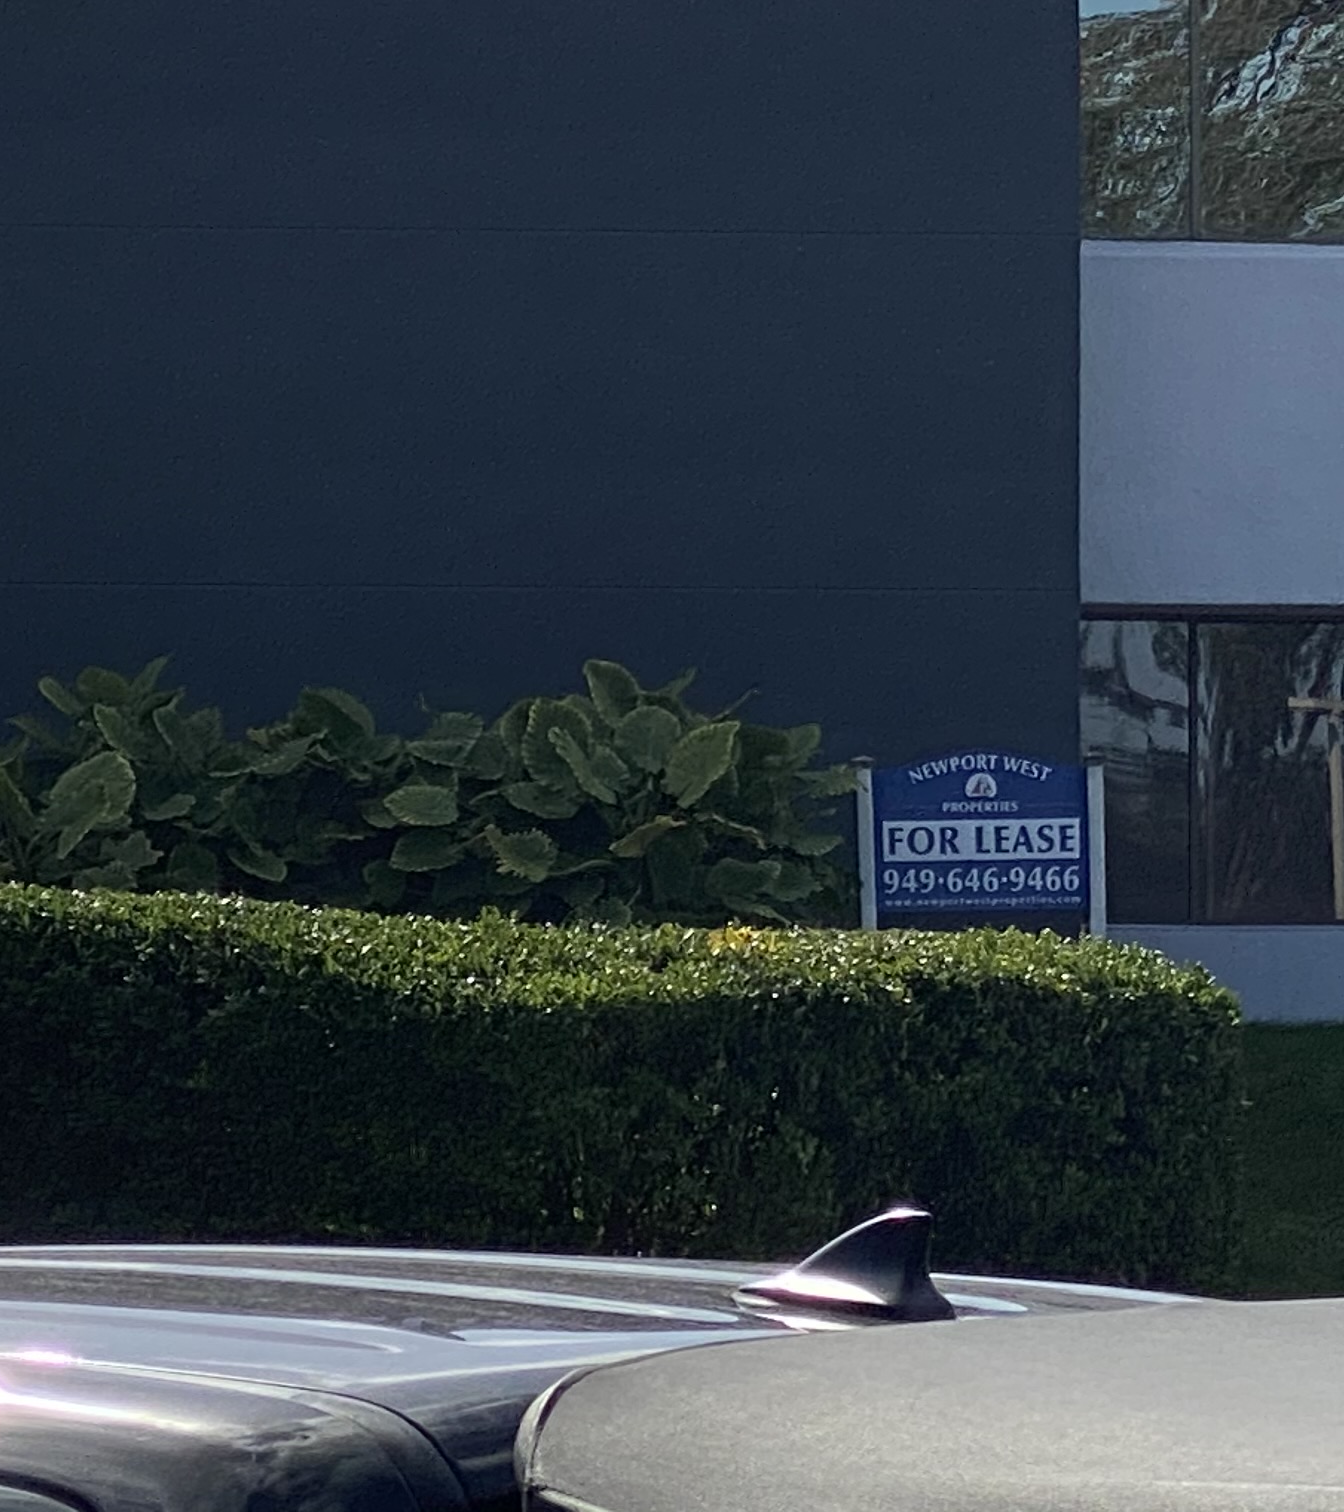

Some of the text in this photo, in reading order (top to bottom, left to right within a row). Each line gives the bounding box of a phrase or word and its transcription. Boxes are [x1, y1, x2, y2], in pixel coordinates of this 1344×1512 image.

[907, 754, 1053, 785] NEWPORT WEST
[941, 800, 1019, 813] PROPERTIES
[887, 824, 1076, 856] FOR LEASE
